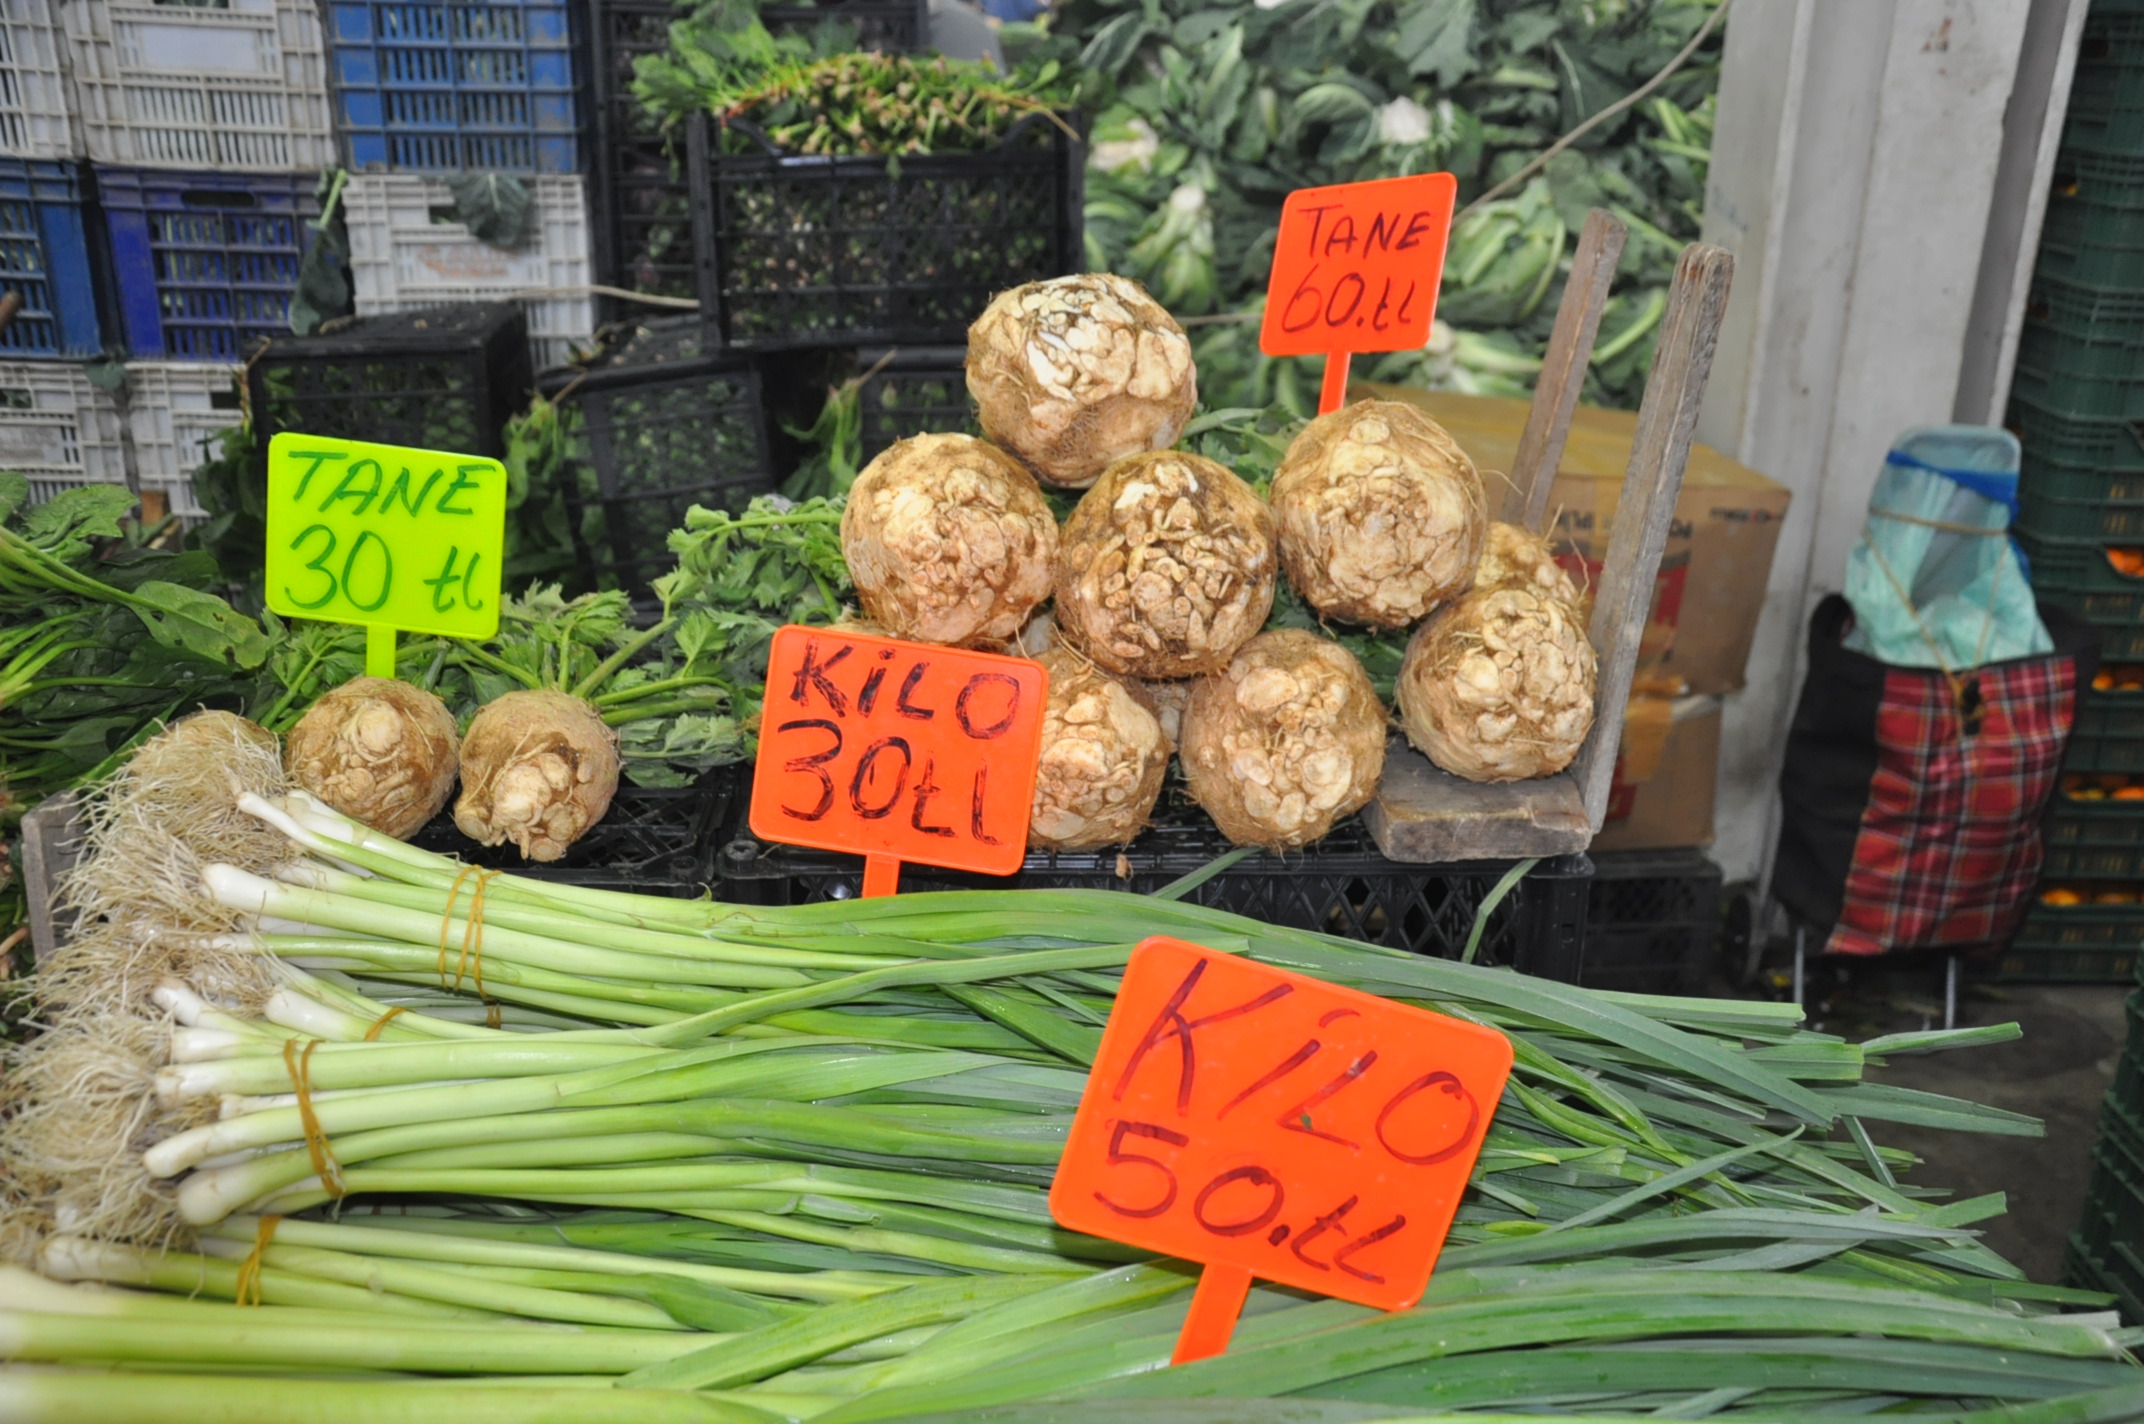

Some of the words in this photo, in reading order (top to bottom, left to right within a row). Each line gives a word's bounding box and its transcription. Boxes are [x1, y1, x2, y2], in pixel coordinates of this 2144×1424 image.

[1296, 203, 1432, 260] TANE
[287, 450, 497, 518] TANE
[284, 523, 393, 613] 30
